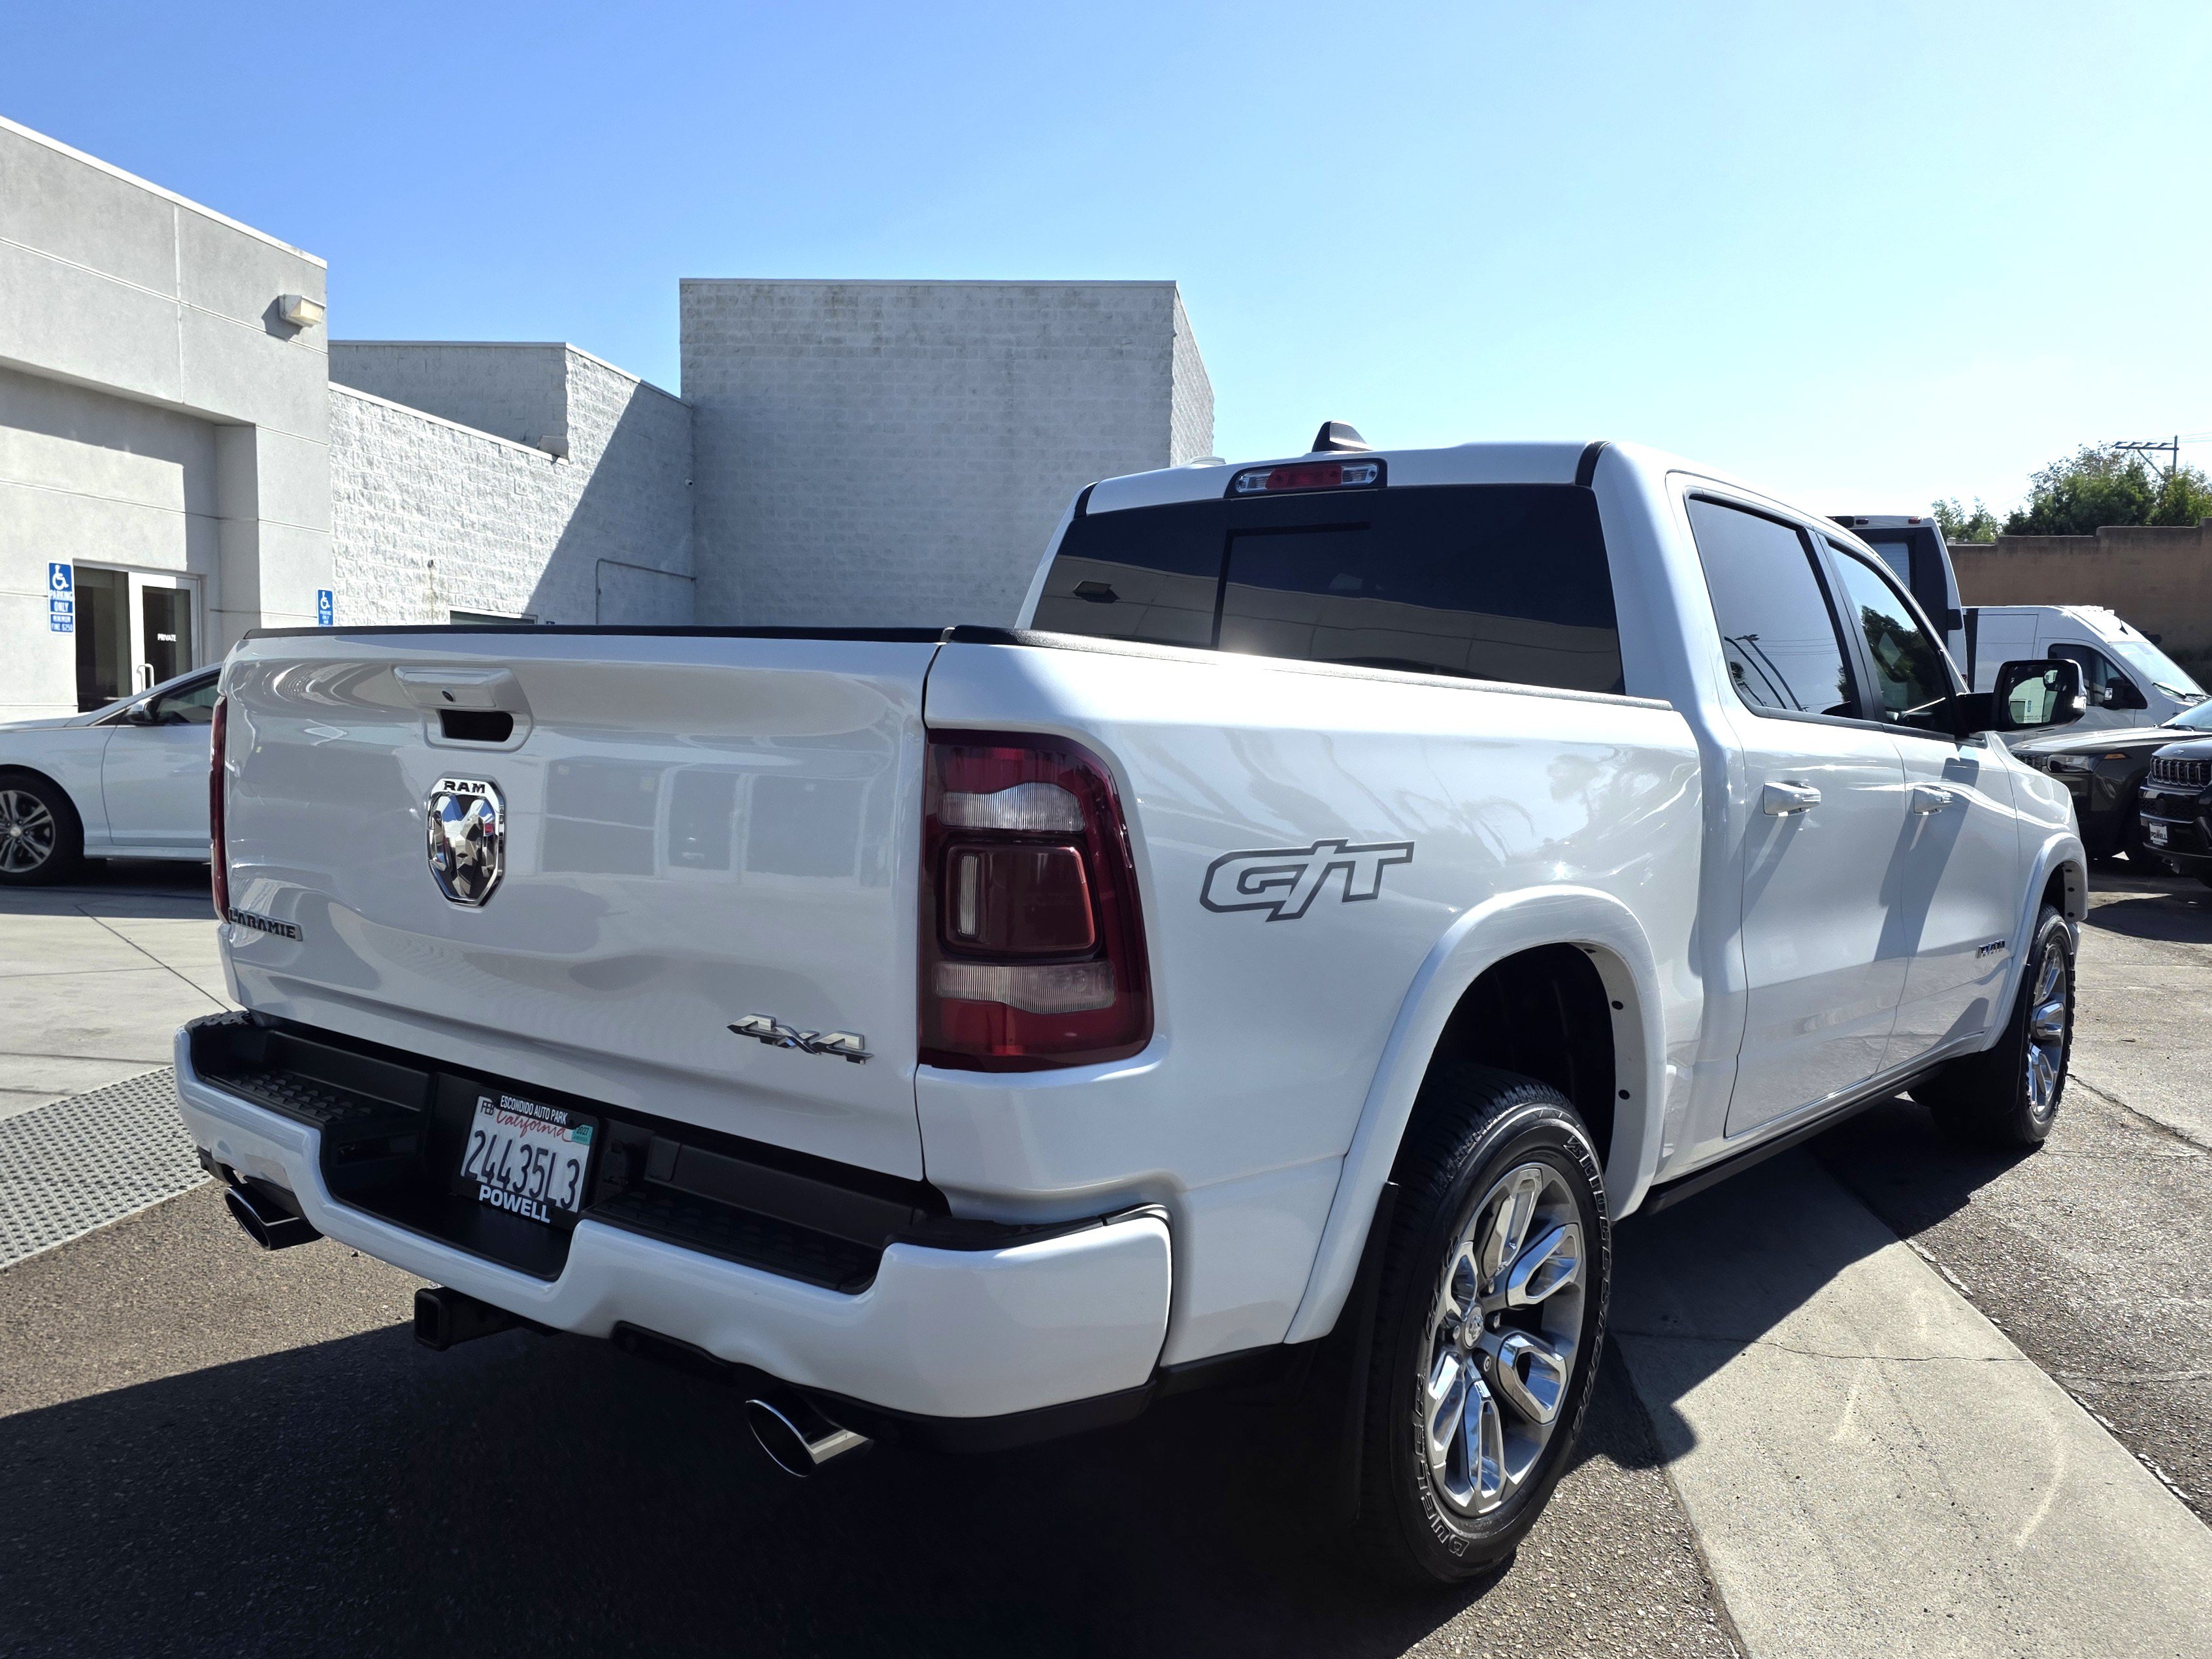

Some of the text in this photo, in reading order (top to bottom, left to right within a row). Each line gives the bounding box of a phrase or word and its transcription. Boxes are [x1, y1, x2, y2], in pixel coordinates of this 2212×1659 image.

[54, 600, 69, 612] ONLY
[157, 633, 176, 642] PRIVATE
[442, 780, 486, 793] RAM
[229, 908, 297, 939] LARAMIE
[480, 1100, 495, 1116] FEB
[500, 1095, 568, 1125] ESCONDIDO AUTO PARK
[478, 1184, 551, 1223] POWELL
